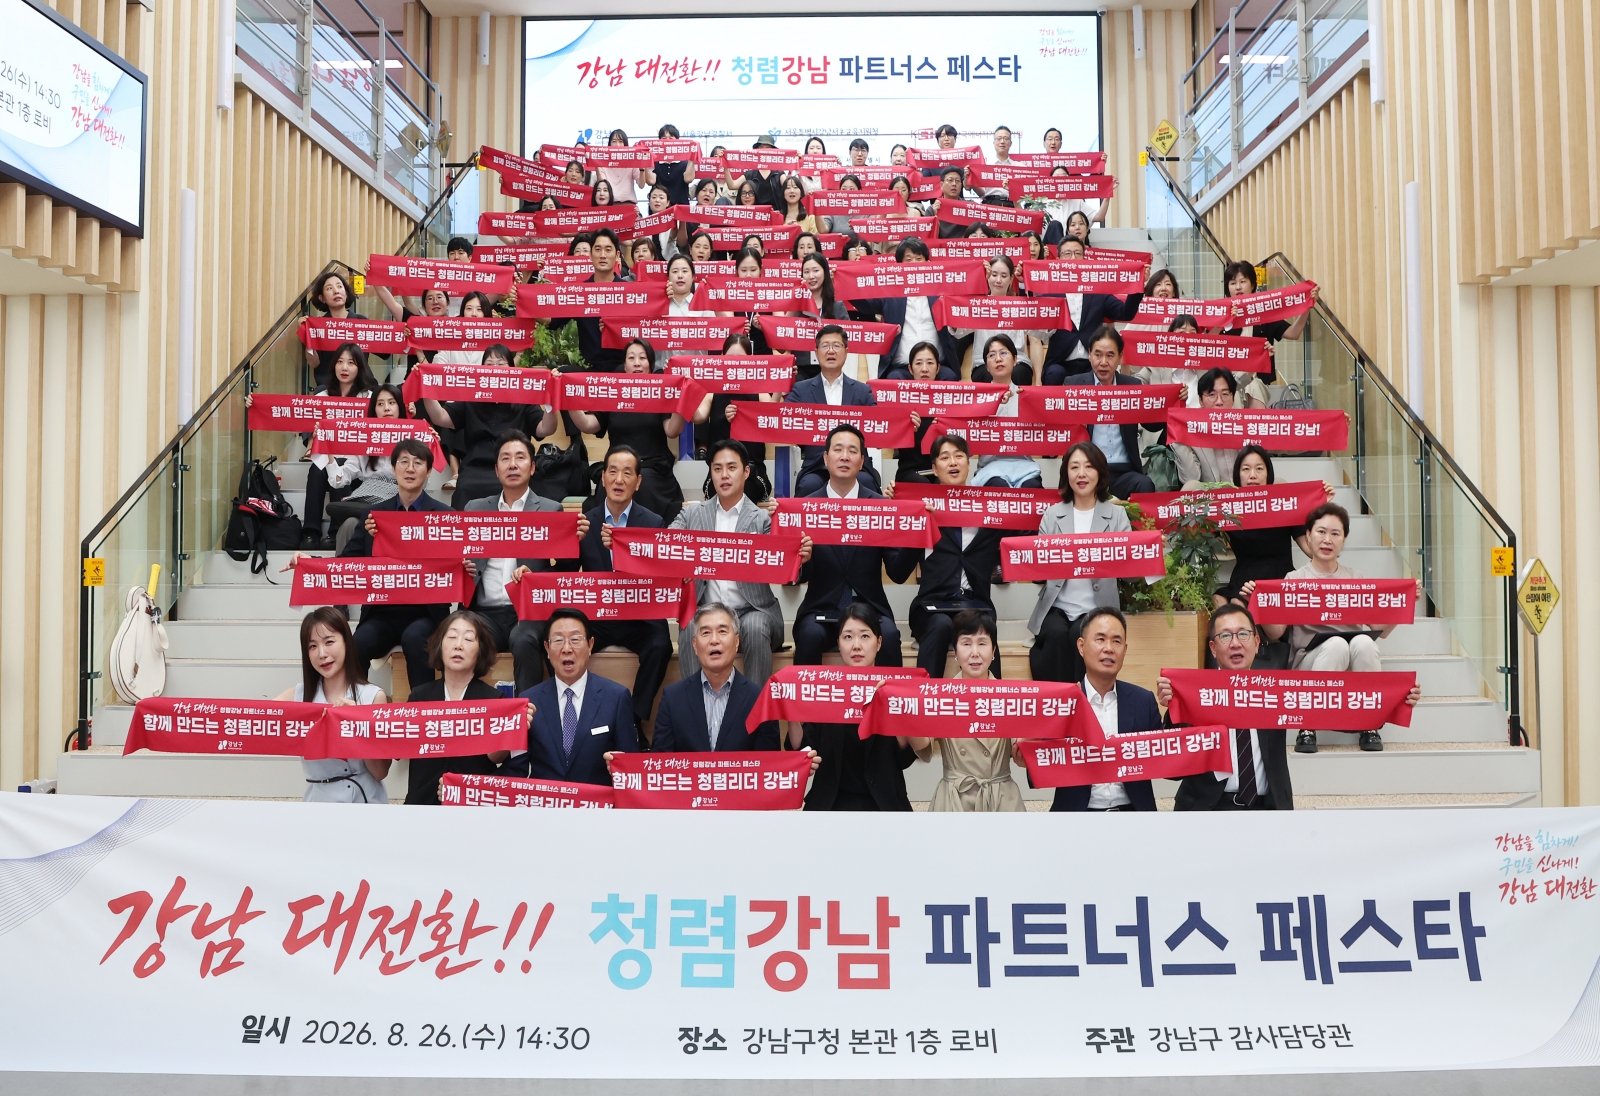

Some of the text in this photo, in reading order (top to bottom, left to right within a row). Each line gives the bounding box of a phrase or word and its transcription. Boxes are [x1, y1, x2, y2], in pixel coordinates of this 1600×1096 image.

[1040, 46, 1055, 57] 강남
[72, 64, 91, 87] 강남을
[577, 55, 1022, 89] 강남 대전환!! 청렴강남 파트너스 페스타
[34, 81, 60, 108] 14:30
[72, 84, 112, 118] 구민을 신나게!
[18, 101, 31, 122] 1층
[34, 110, 51, 134] 로비
[72, 106, 126, 149] 강남 대전환!!
[857, 272, 966, 287] 함께 만드는 청렴리더 강남!
[537, 294, 647, 305] 함께 만드는 청렴리더 강남!
[422, 374, 546, 390] 함께 만드는 청렴리더 강남!
[1187, 422, 1320, 436] 함께 만드는 청렴리더 강남!
[778, 512, 926, 530] 함께 만드는 청렴리더 강남!
[401, 526, 548, 540] 함께 만드는 청렴리더 강남!
[629, 542, 784, 566] 함께 만드는 청렴리더 강남!
[1257, 593, 1406, 608] 함께 만드는 청렴리더 강남!
[1526, 593, 1540, 602] 손잡이
[919, 682, 939, 695] 강남
[941, 682, 968, 694] 대전환
[996, 686, 1020, 694] 파트너스
[1020, 686, 1040, 694] 페스타
[1230, 674, 1249, 687] 강남
[1251, 674, 1276, 687] 대전환
[888, 696, 1076, 716] 함께 만드는 청렴리더 강남!
[1199, 689, 1381, 709] 함께 만드는 청렴리더 강남!
[340, 714, 521, 738] 함께 만드는 청렴리더 강남!
[642, 758, 662, 770] 강남
[664, 758, 690, 770] 대전환
[718, 760, 741, 768] 파트너스
[742, 760, 760, 768] 페스타
[612, 772, 798, 790] 함께 만드는 청렴리더 강남!
[1494, 829, 1580, 852] 강남을 힘차게!
[1499, 854, 1579, 877] 구민을 신나게!
[1498, 875, 1598, 906] 강남 대전환
[99, 876, 1486, 992] 강남 대전환!! 청렴강남 파트너스 페스타
[242, 1015, 590, 1050] 일시 2026. 8. 26.(수) 14:30
[678, 1027, 997, 1055] 장소 강남구청 본관 1층 로비
[1086, 1024, 1353, 1053] 주관 강남구 감사담당관
